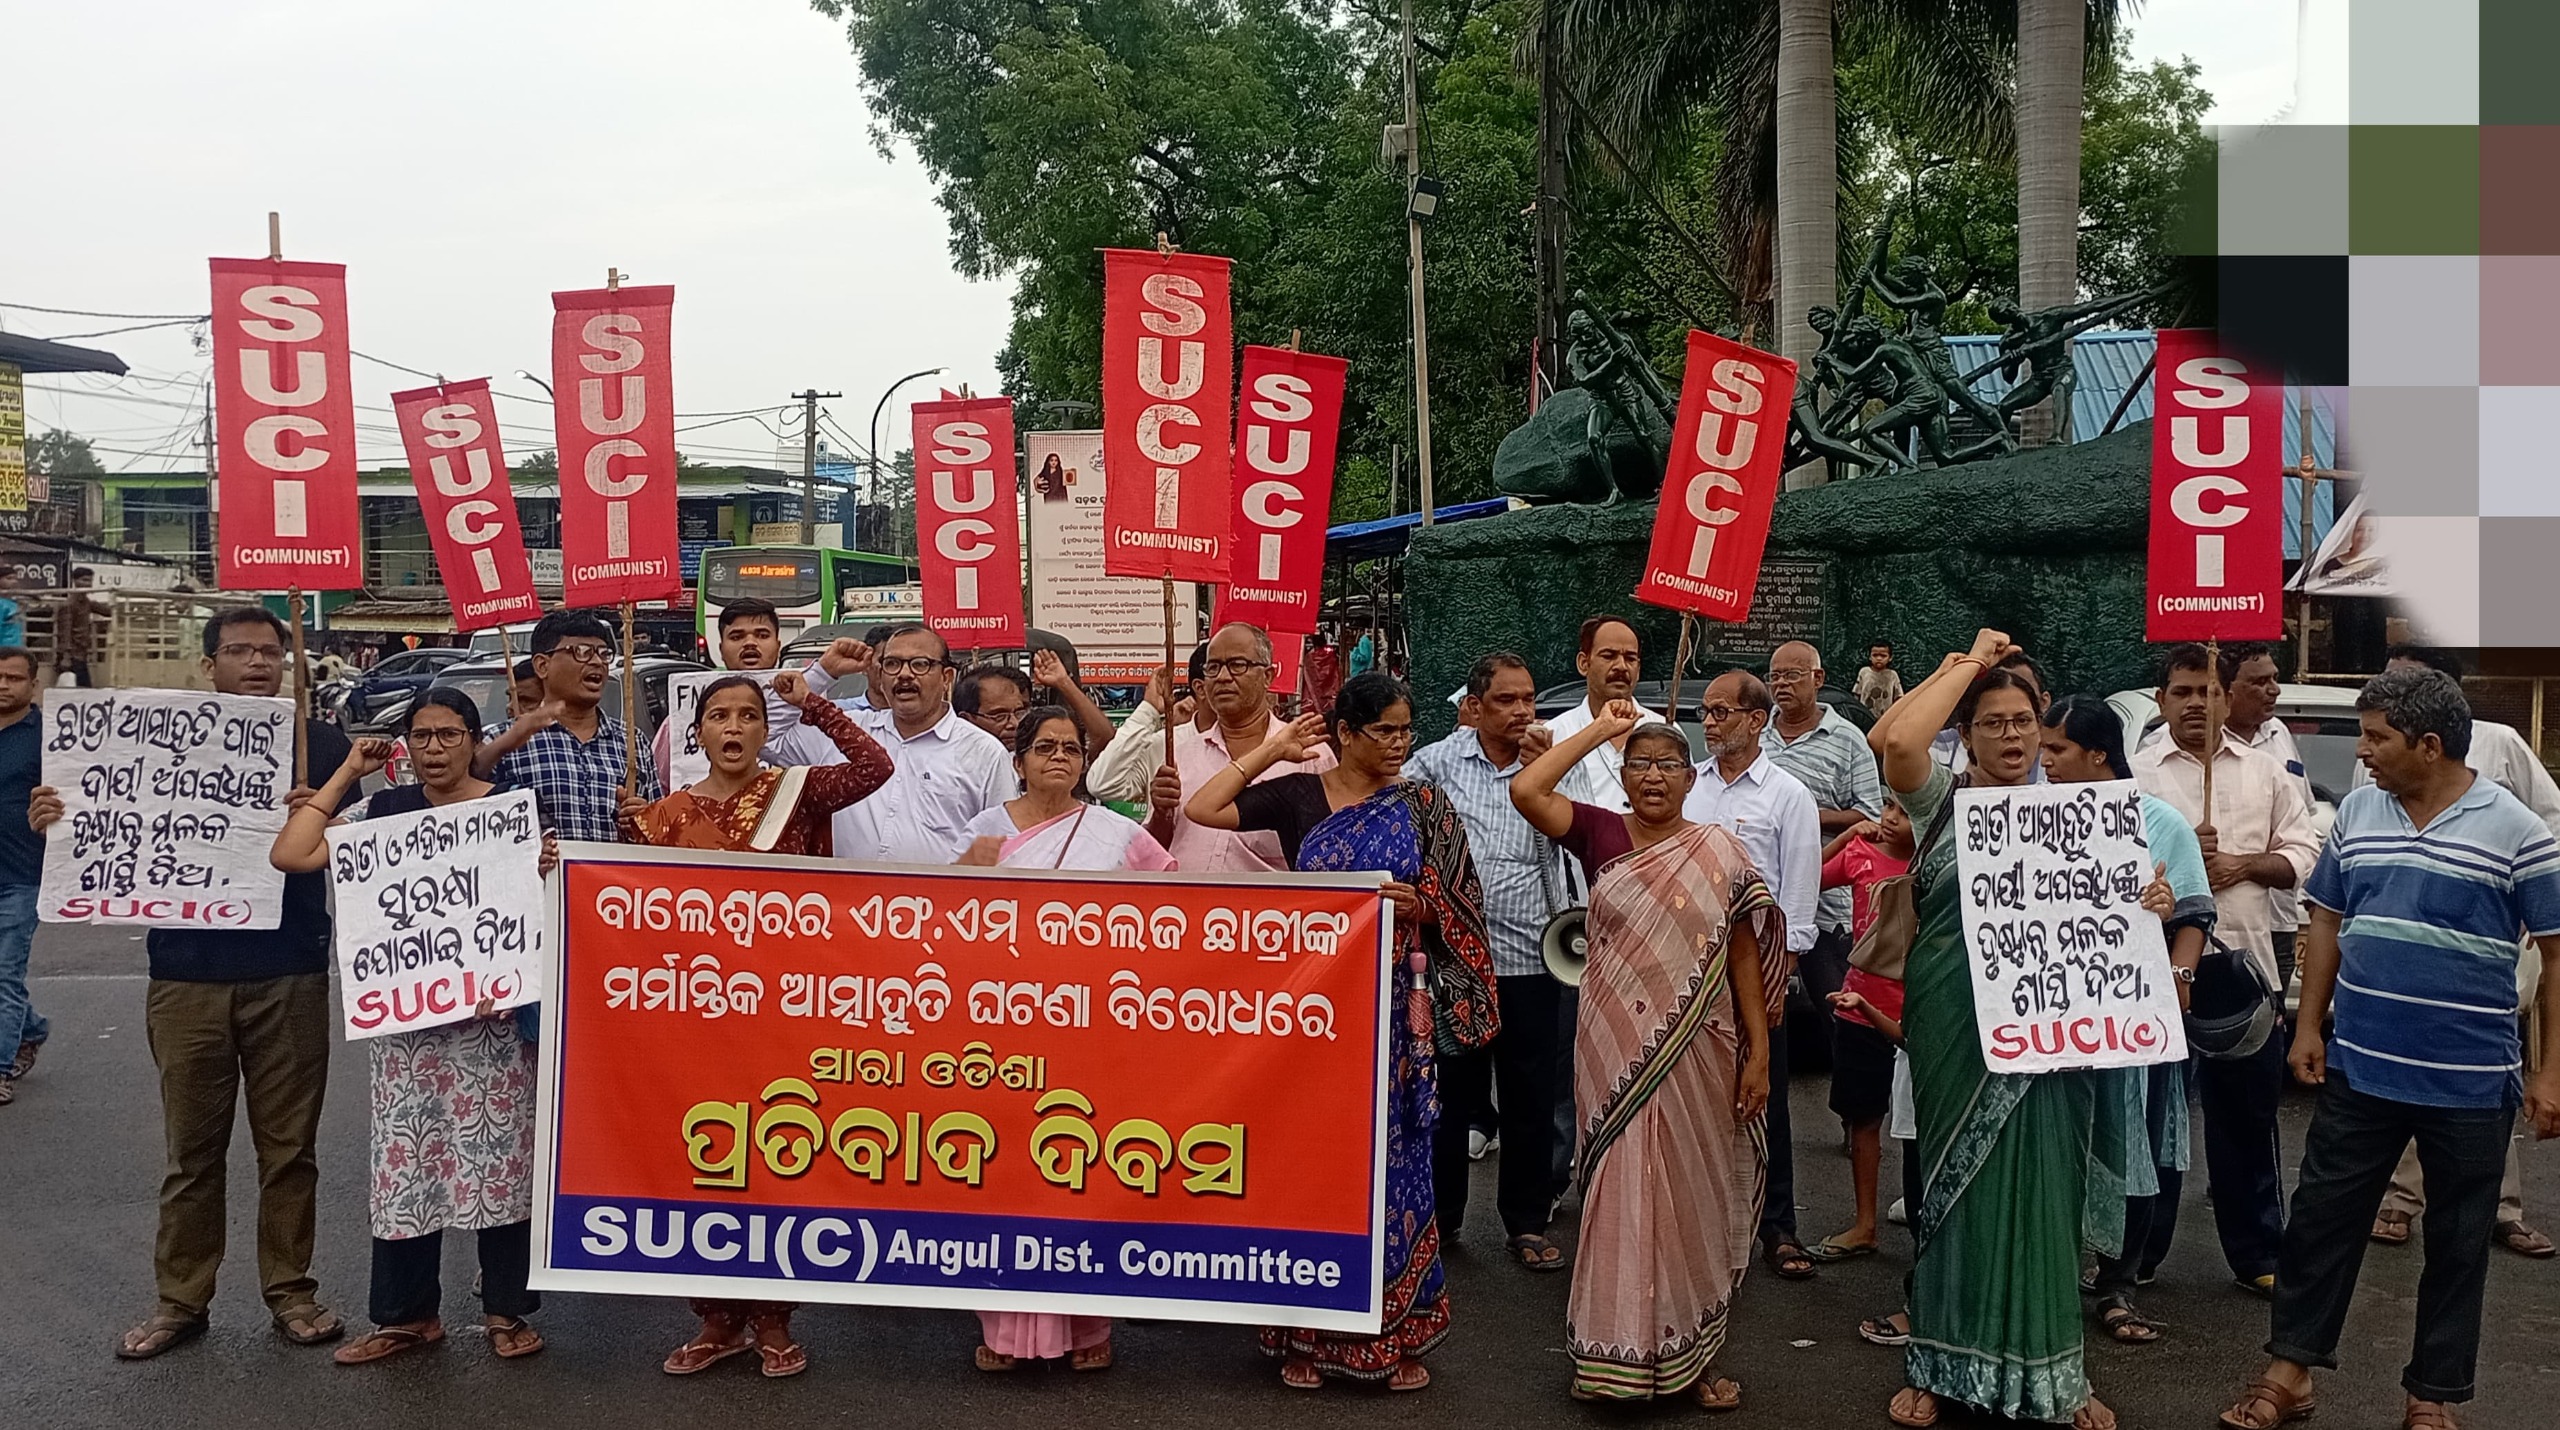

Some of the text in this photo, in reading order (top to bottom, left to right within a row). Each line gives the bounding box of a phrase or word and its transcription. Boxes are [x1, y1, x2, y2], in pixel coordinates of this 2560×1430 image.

[239, 285, 330, 537] SUCI
[578, 314, 648, 558] SUCI
[1136, 273, 1206, 528] SUCI
[420, 402, 503, 593] SUCI
[1242, 373, 1313, 581] SUCI
[1685, 358, 1766, 578] SUCI
[2169, 356, 2251, 587] SUCI
[233, 544, 350, 568] (COMMUNIST)
[931, 421, 995, 609] SUCI
[1114, 525, 1219, 559] (COMMUNIST)
[463, 593, 533, 619] (COMMUNIST)
[572, 556, 668, 586] (COMMUNIST)
[1229, 583, 1307, 609] (COMMUNIST)
[1652, 566, 1739, 607] (COMMUNIST)
[2157, 592, 2264, 615] (COMMUNIST)
[928, 614, 1009, 632] (COMMUNIST)
[1036, 901, 1187, 952] କଲେଜ
[1202, 907, 1350, 962] ଛାତ୍ରୀଙ୍କ
[603, 953, 1338, 1041] ମର୍ମାନ୍ତିକ ଆତ୍ମାହୁତି ଘଟଣା ବିରୋଧରେ
[808, 1046, 904, 1088] ସାରା
[682, 1077, 1245, 1195] ପ୍ରତିବାଦ ଦିବସ
[581, 1205, 1342, 1289] SUCI(C) Angul Dist. Committee
